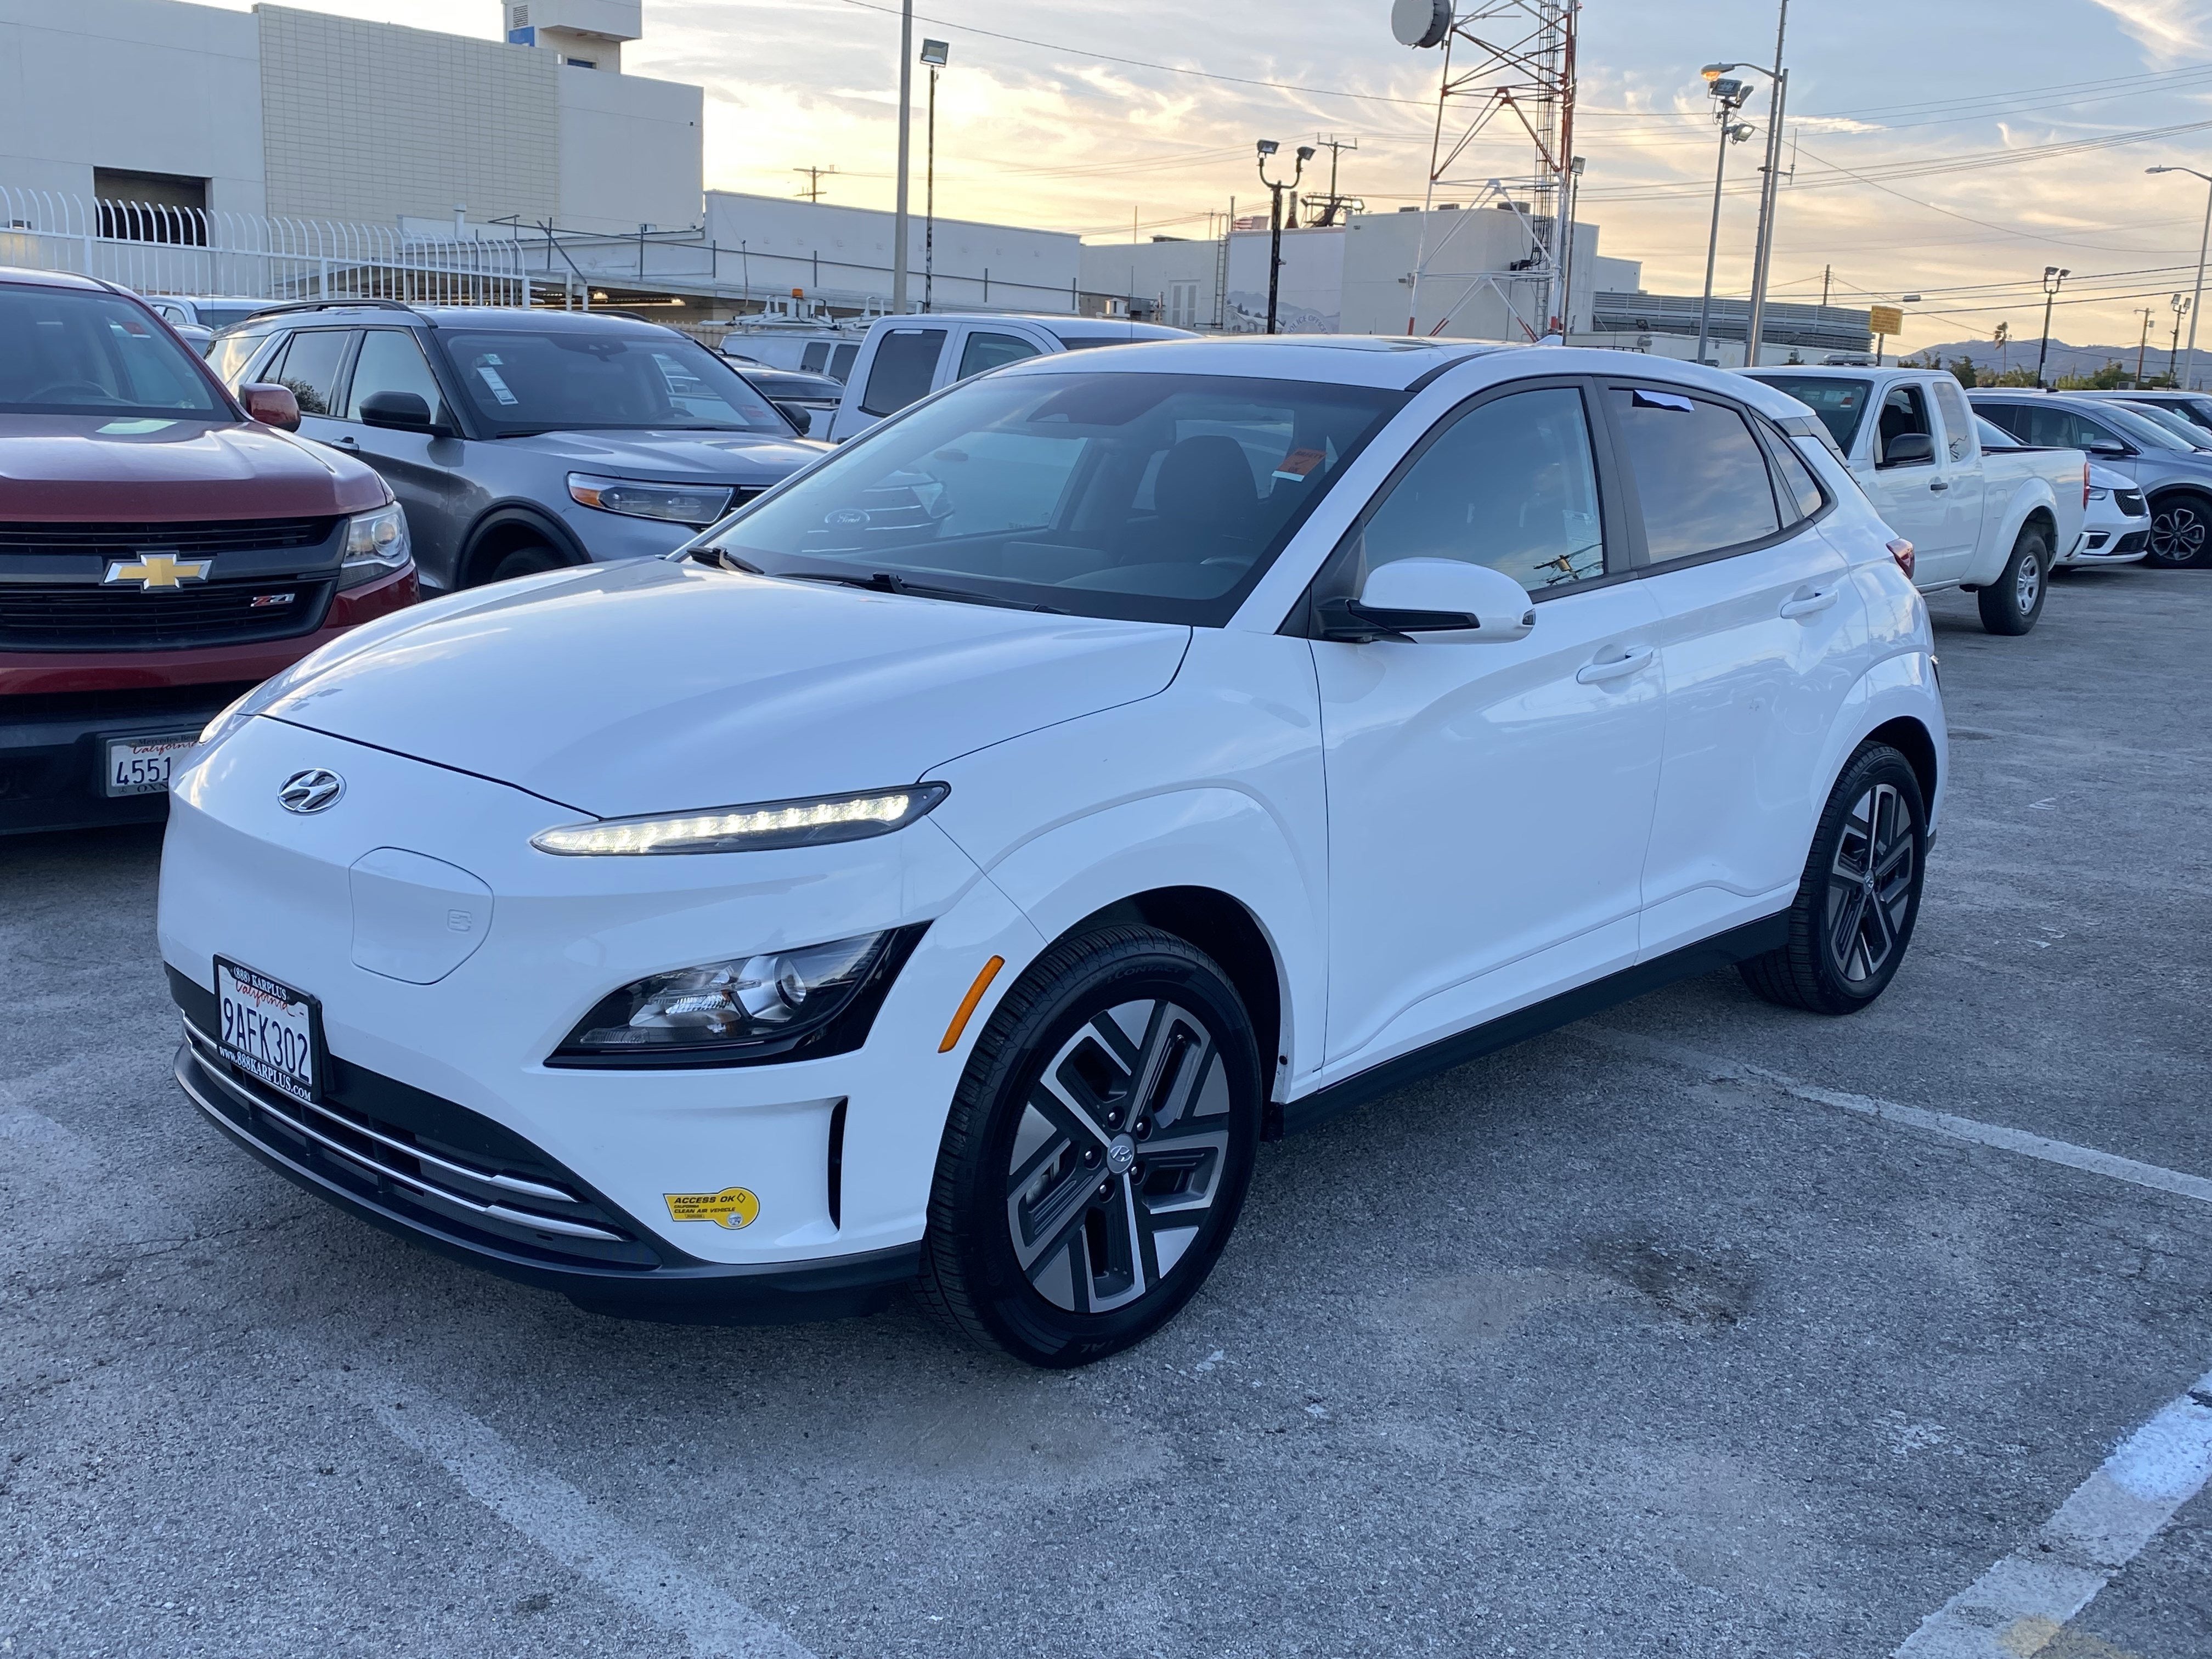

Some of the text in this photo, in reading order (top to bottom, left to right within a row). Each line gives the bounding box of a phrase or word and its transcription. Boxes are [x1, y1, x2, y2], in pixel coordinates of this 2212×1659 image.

[1308, 315, 1328, 334] OFFICE
[250, 593, 295, 607] Z71
[116, 757, 171, 785] 4551
[137, 783, 168, 793] OXN
[234, 966, 287, 1001] (888) KARPLUS
[224, 997, 309, 1083] 9AFK302
